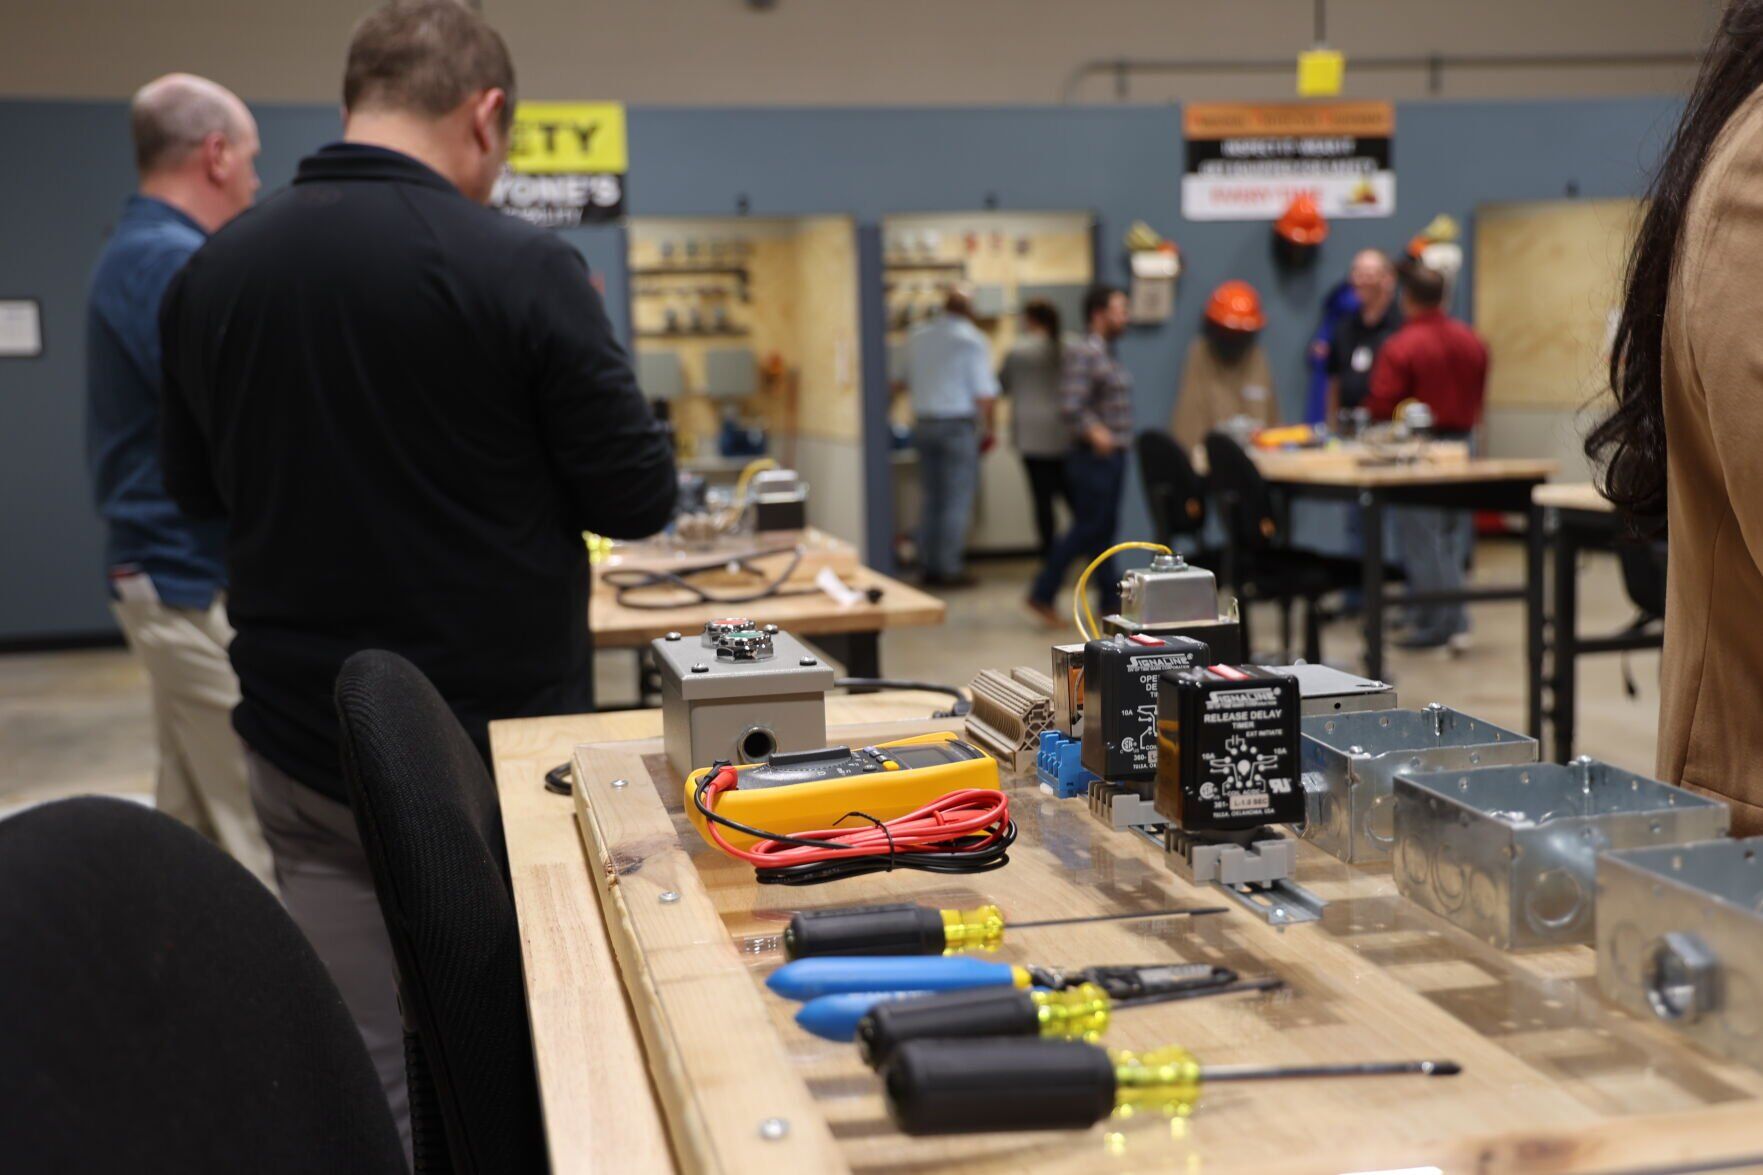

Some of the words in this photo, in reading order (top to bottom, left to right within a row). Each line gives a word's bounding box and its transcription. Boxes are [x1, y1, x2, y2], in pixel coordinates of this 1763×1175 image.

[1129, 653, 1190, 667] SIGNALINE
[1203, 711, 1248, 723] RELEASE
[1250, 709, 1282, 720] DELAY
[1232, 721, 1255, 729] TIMER
